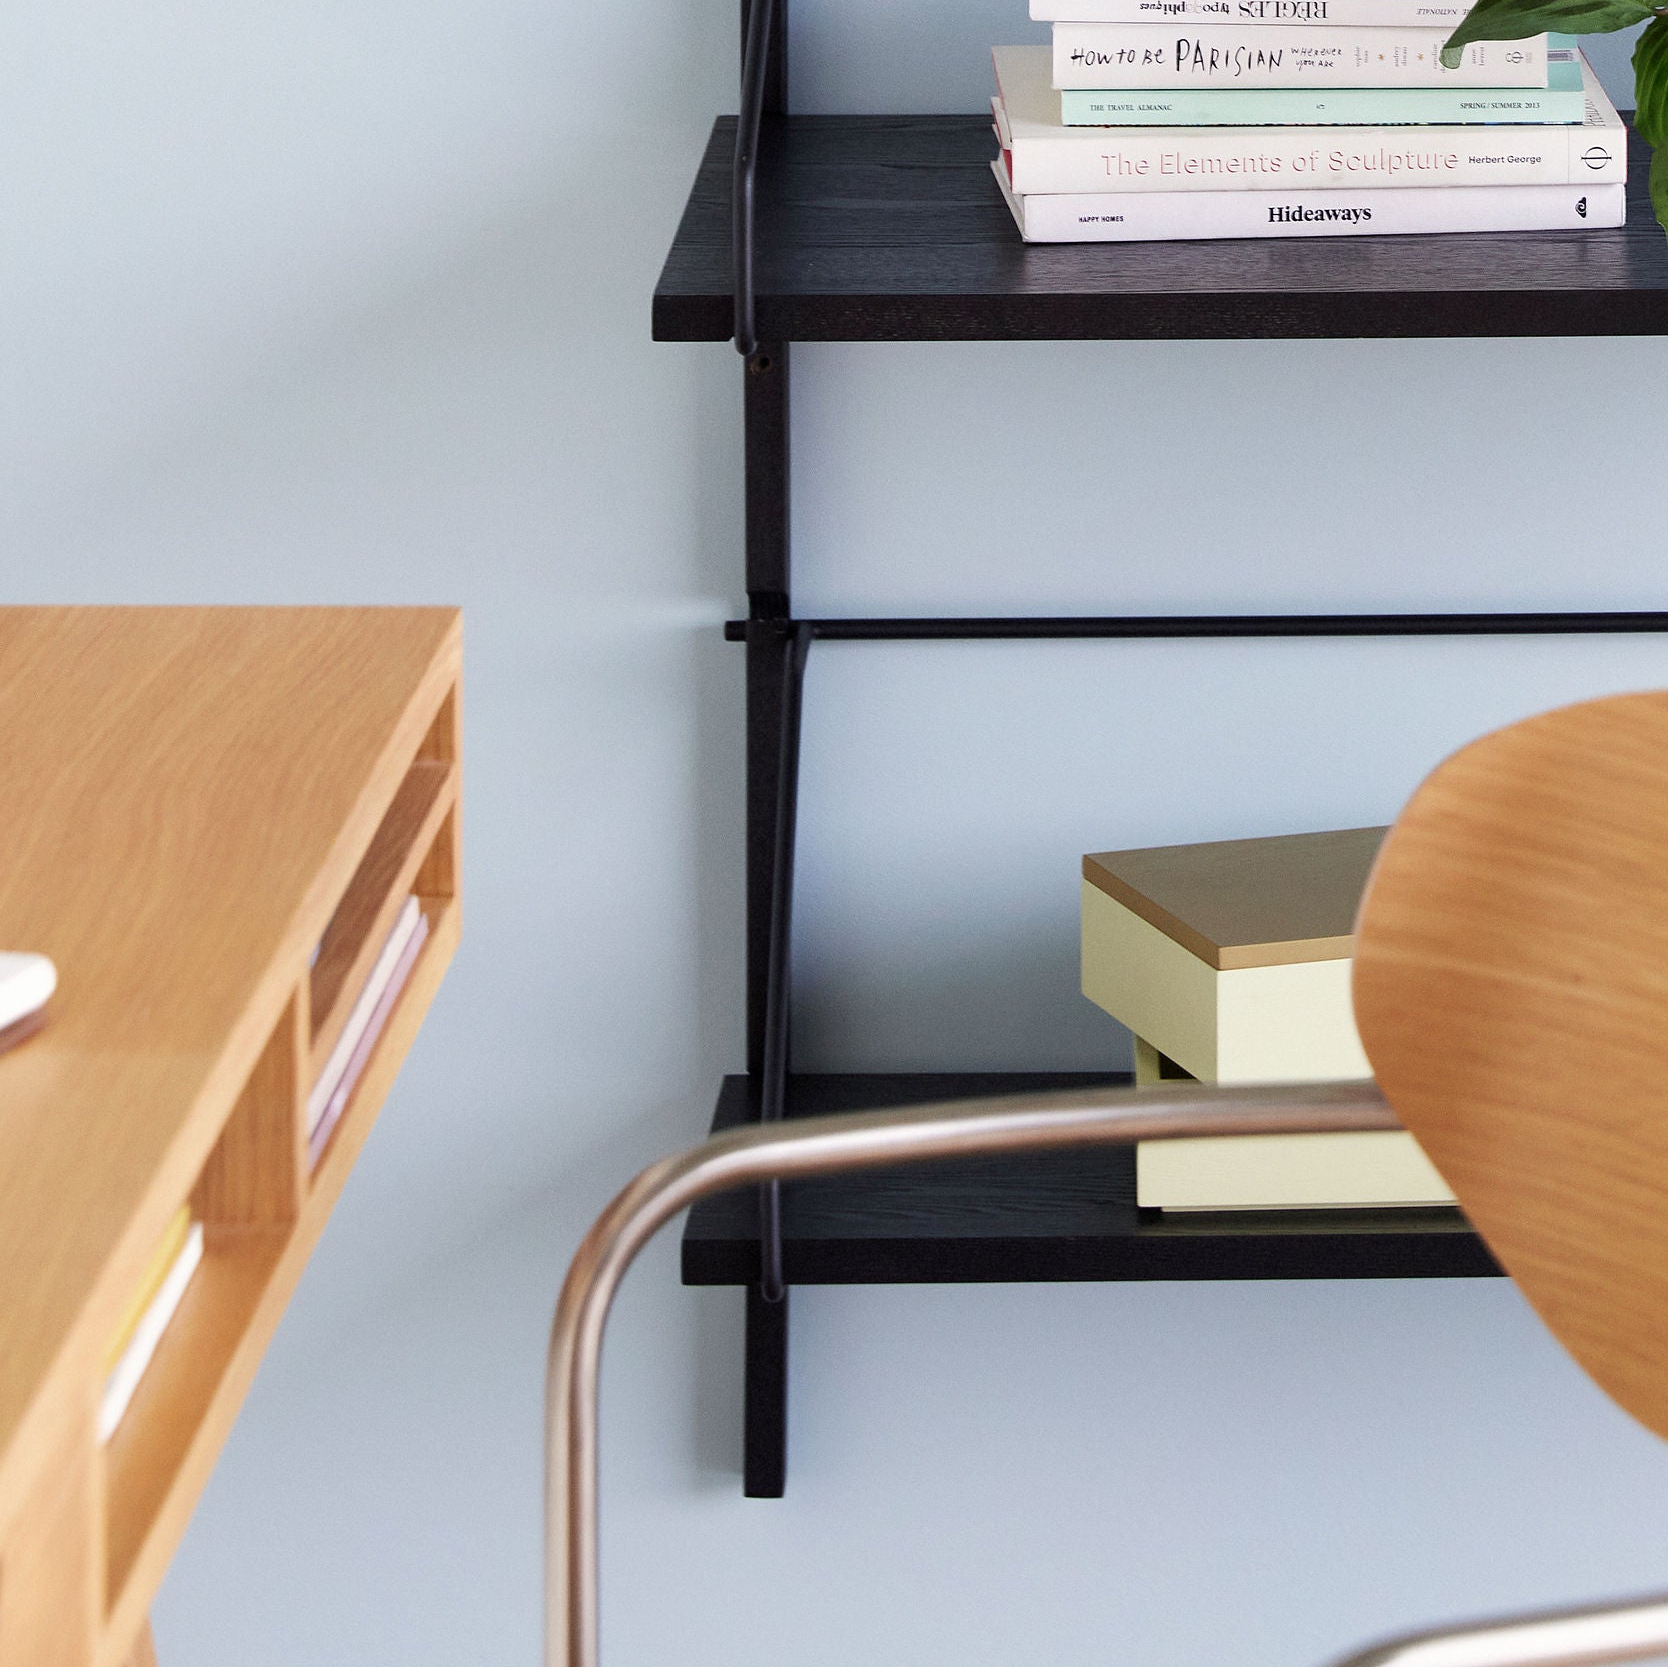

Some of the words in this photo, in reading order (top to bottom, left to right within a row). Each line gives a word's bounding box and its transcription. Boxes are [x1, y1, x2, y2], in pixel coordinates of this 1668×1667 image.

[1238, 0, 1329, 22] RÈGLES
[1415, 8, 1458, 16] NATIONALE
[1175, 38, 1283, 77] PARISIAN
[1100, 152, 1150, 176] The
[1159, 151, 1283, 175] Elements
[1291, 150, 1320, 172] of
[1328, 147, 1460, 175] Sculpture
[1468, 155, 1505, 164] Herbert
[1506, 155, 1542, 165] George
[1078, 215, 1100, 224] HAPPY
[1100, 215, 1125, 223] HOMES
[1267, 205, 1372, 224] Hideaways
